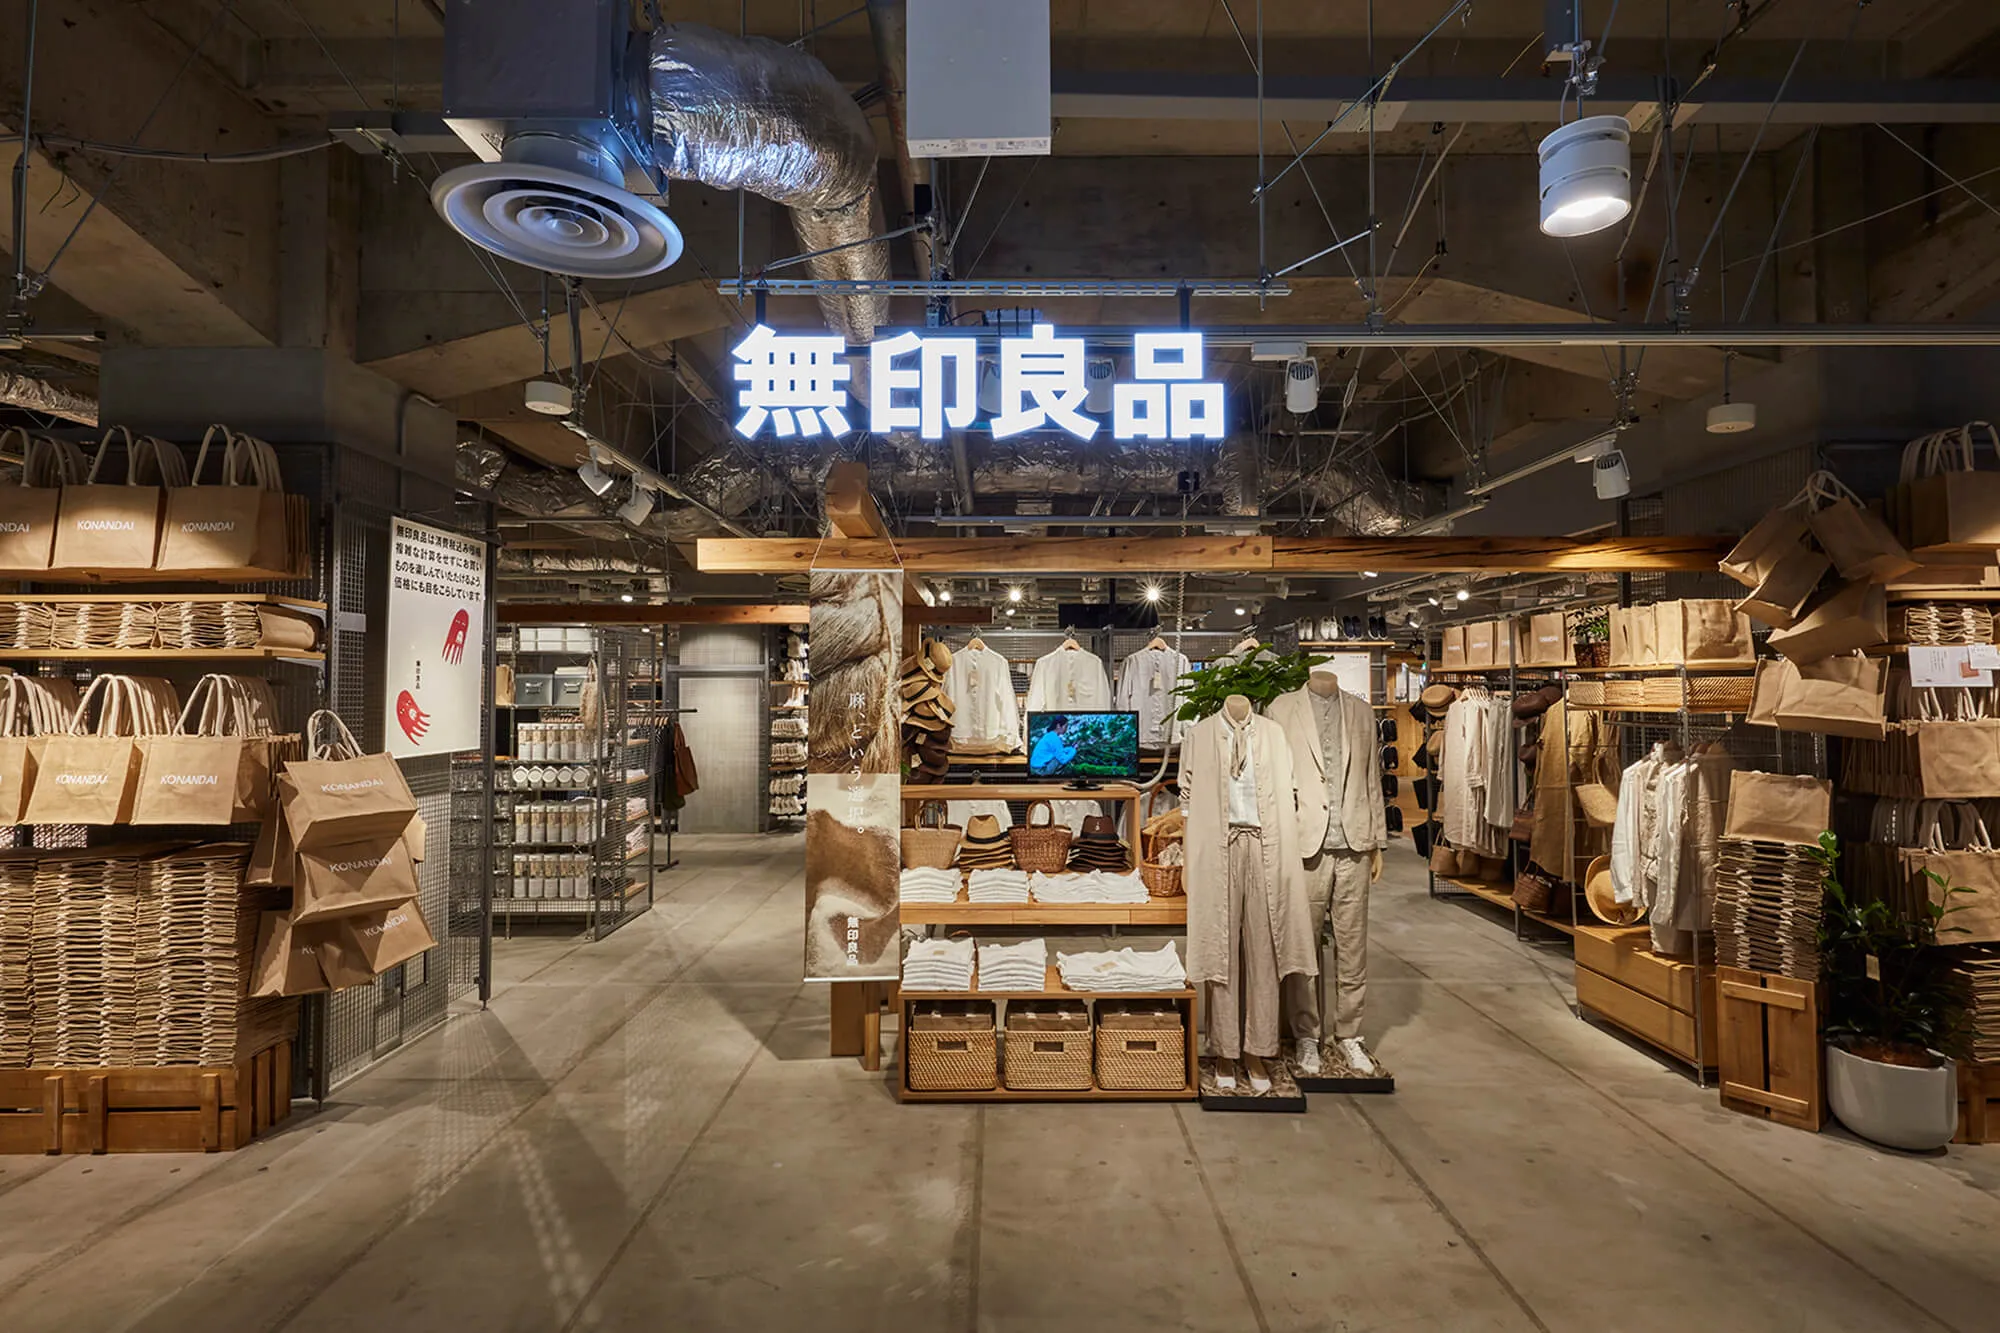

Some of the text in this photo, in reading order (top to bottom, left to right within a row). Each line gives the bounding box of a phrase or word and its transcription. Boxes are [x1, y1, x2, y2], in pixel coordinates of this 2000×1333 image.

[734, 324, 1224, 440] 無印良品
[77, 520, 135, 531] KONANDAI
[181, 521, 235, 533] KONANDAI
[160, 775, 218, 785] KONANDAI
[320, 778, 384, 792] KONANDAI
[329, 857, 392, 872] KONANDAI
